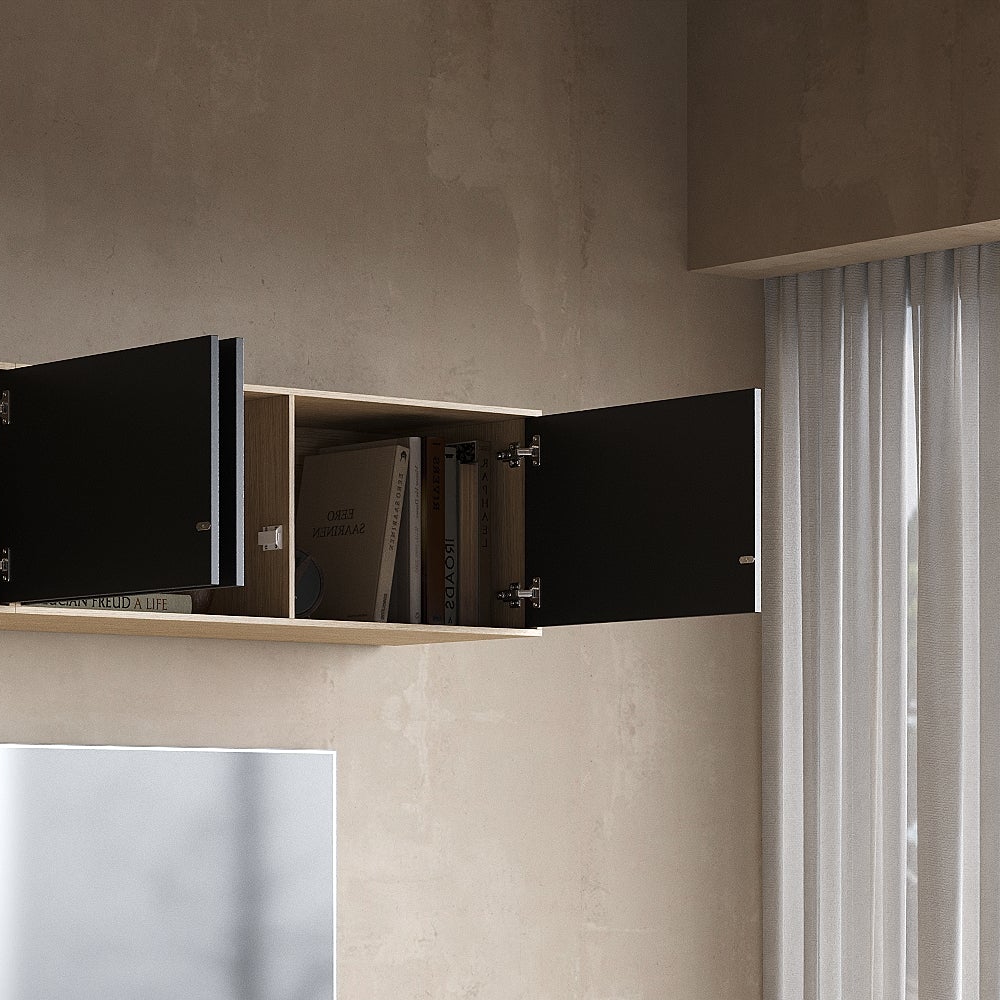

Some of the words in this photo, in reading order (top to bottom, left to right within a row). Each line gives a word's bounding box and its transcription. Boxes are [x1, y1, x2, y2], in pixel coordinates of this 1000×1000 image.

[92, 596, 131, 609] FREUD
[133, 598, 142, 609] A
[146, 598, 168, 611] LIFE
